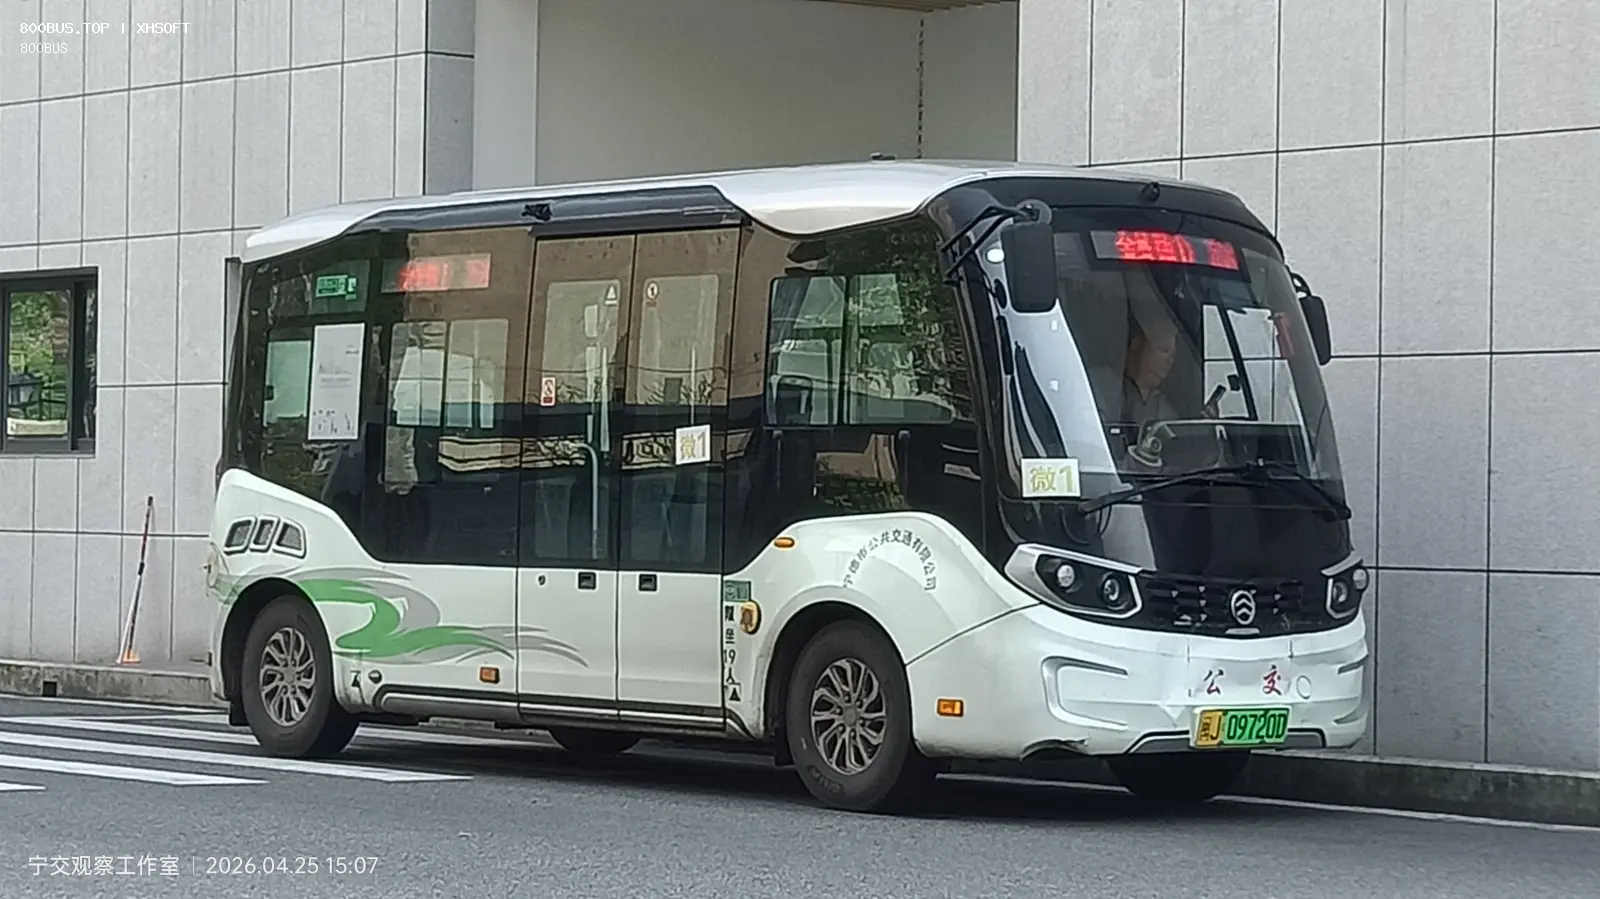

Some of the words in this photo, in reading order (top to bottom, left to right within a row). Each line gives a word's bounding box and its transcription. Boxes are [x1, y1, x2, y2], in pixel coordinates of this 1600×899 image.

[1030, 465, 1073, 493] 微1
[842, 528, 937, 591] 宁德市公共交通有限公司
